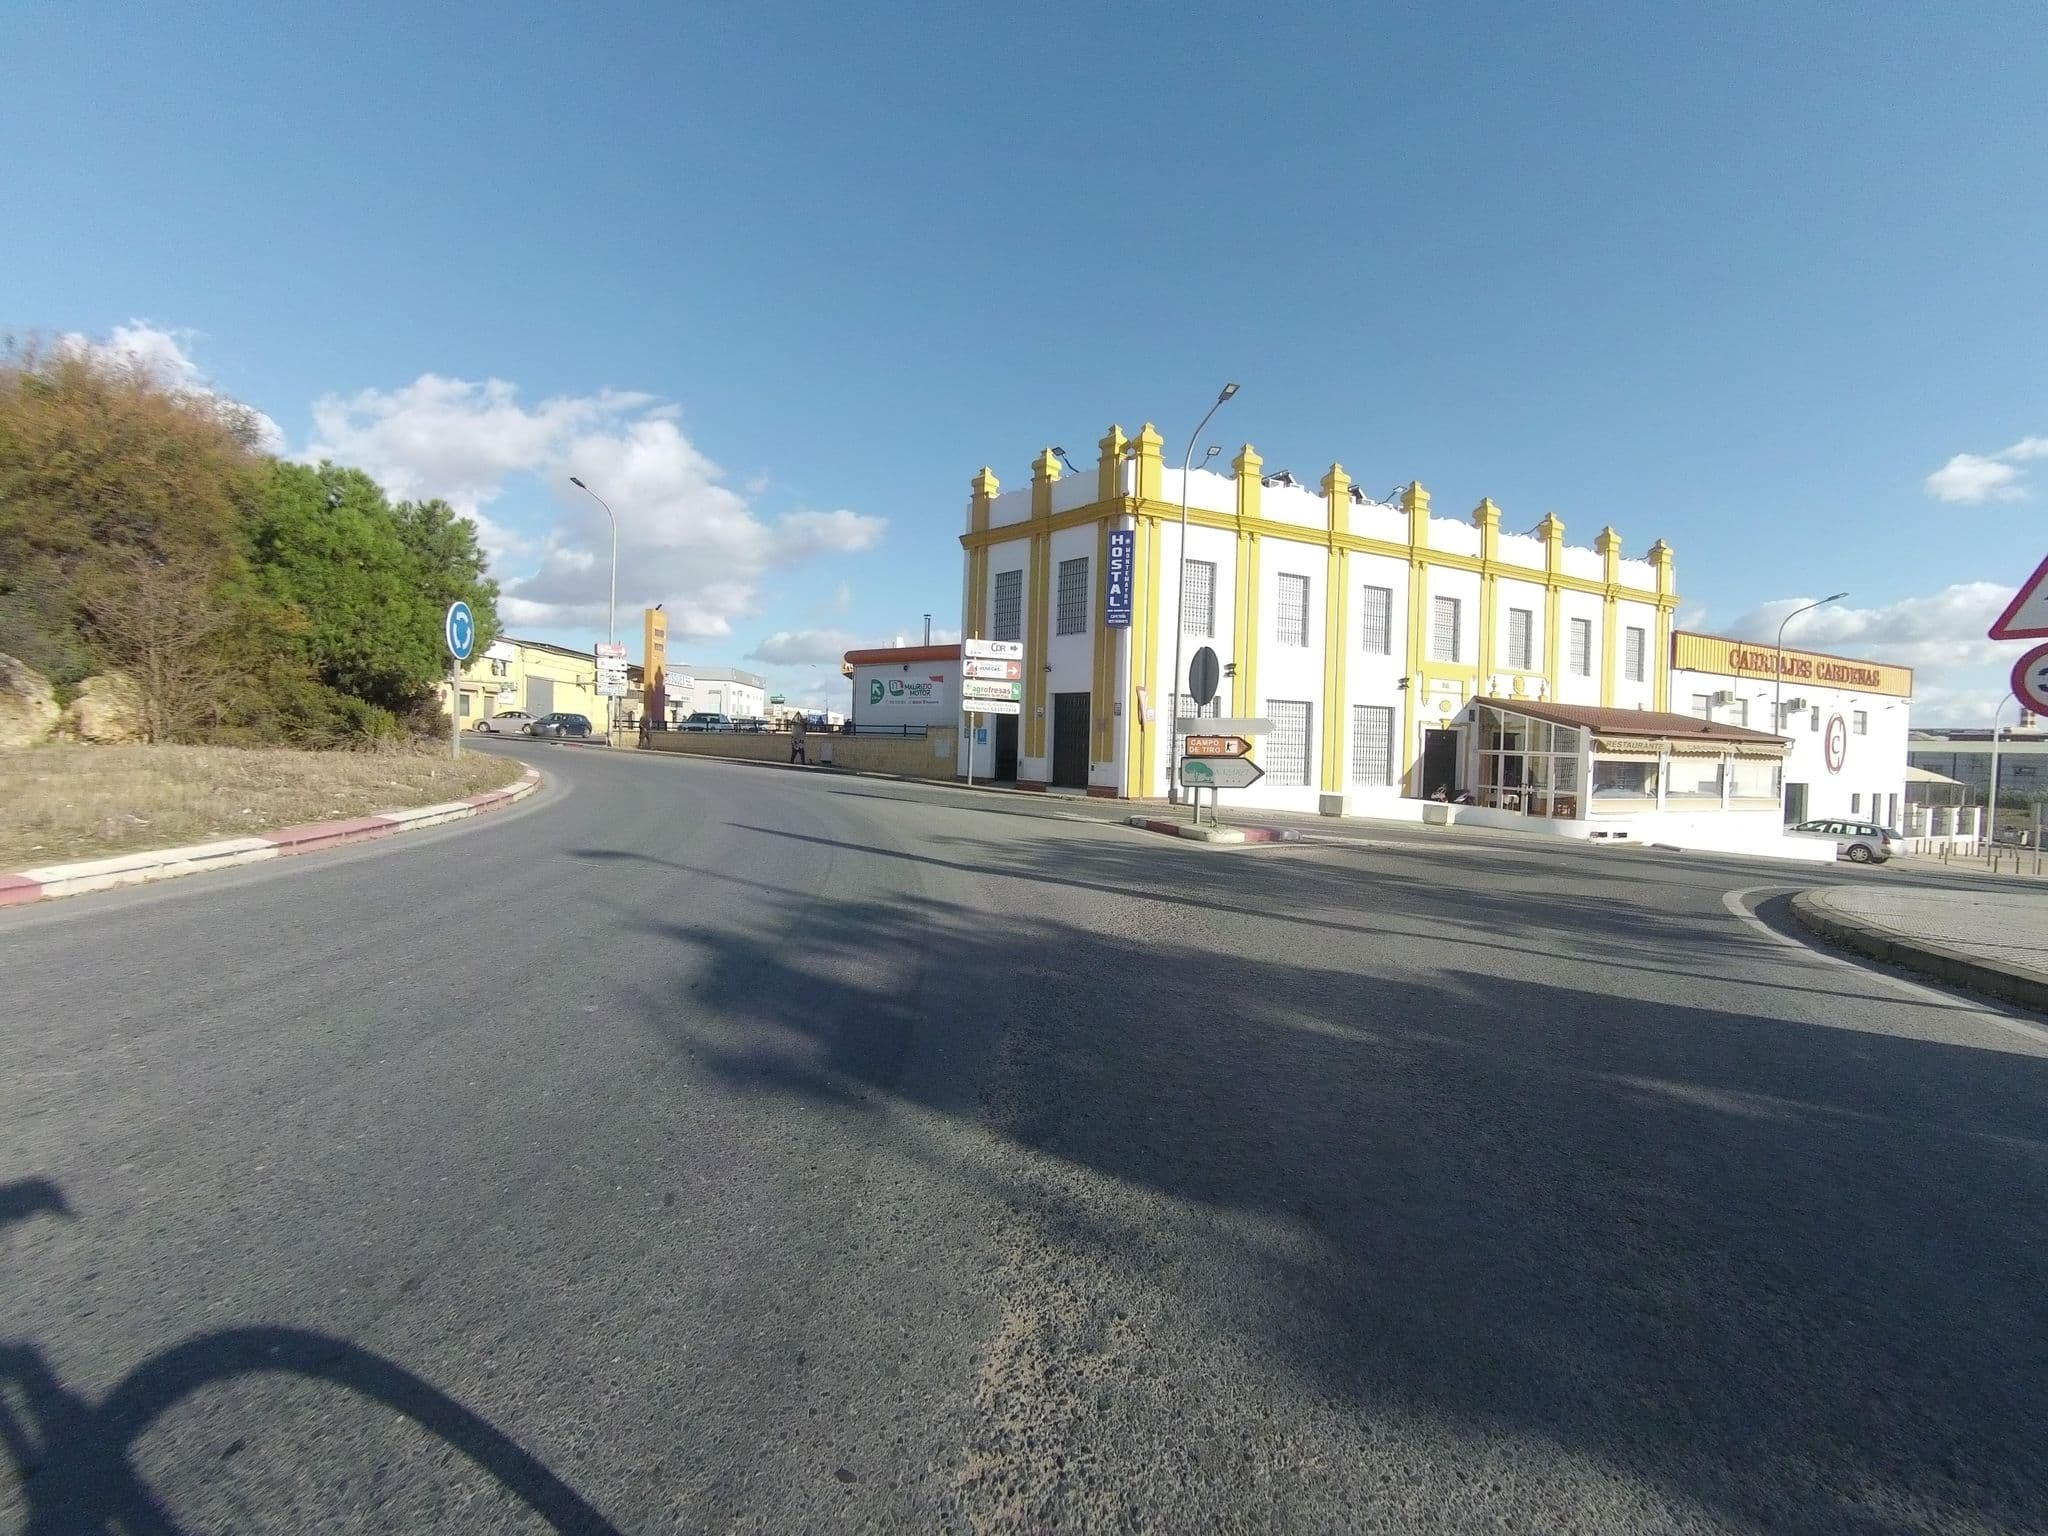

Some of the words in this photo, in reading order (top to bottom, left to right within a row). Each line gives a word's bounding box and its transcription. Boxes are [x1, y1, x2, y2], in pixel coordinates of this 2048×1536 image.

[1109, 534, 1124, 607] HOSTAL
[1729, 649, 1813, 678] CARRUAJES
[1816, 661, 1880, 687] CARDENAS
[972, 686, 1010, 694] agrofresas
[1606, 740, 1664, 750] RESTAURANTE
